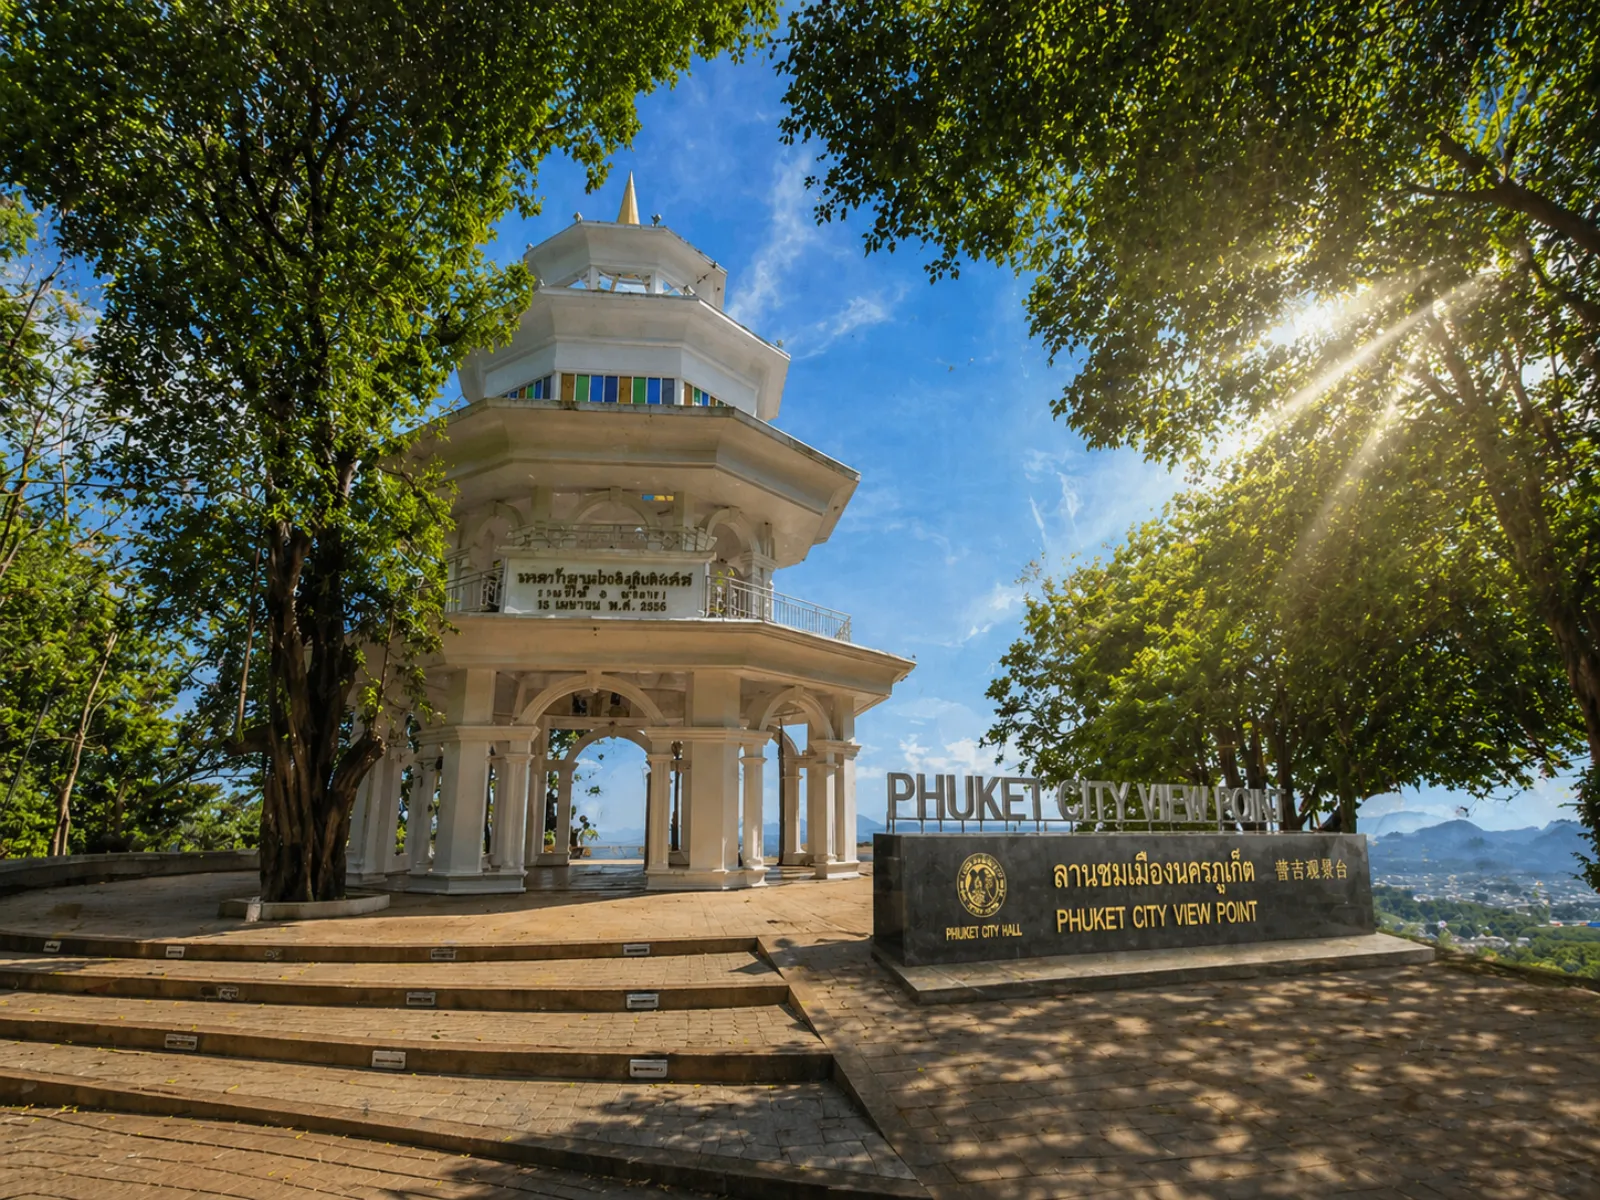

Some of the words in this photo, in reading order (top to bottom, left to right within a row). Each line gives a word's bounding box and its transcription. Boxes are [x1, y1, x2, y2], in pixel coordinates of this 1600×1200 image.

[887, 772, 1042, 820] PHUKET
[1057, 779, 1131, 821] CITY
[1137, 783, 1208, 822] VIEW
[1214, 786, 1286, 822] POINT
[1053, 848, 1255, 894] ลานชมเมืองนครภูเก็ต
[946, 926, 979, 941] PHUKET
[982, 925, 1000, 938] CITY
[1002, 924, 1023, 937] HALL
[1056, 906, 1126, 933] PHUKET
[1132, 904, 1168, 929] CITY
[1173, 902, 1211, 926] VIEW
[1216, 901, 1258, 924] POINT
